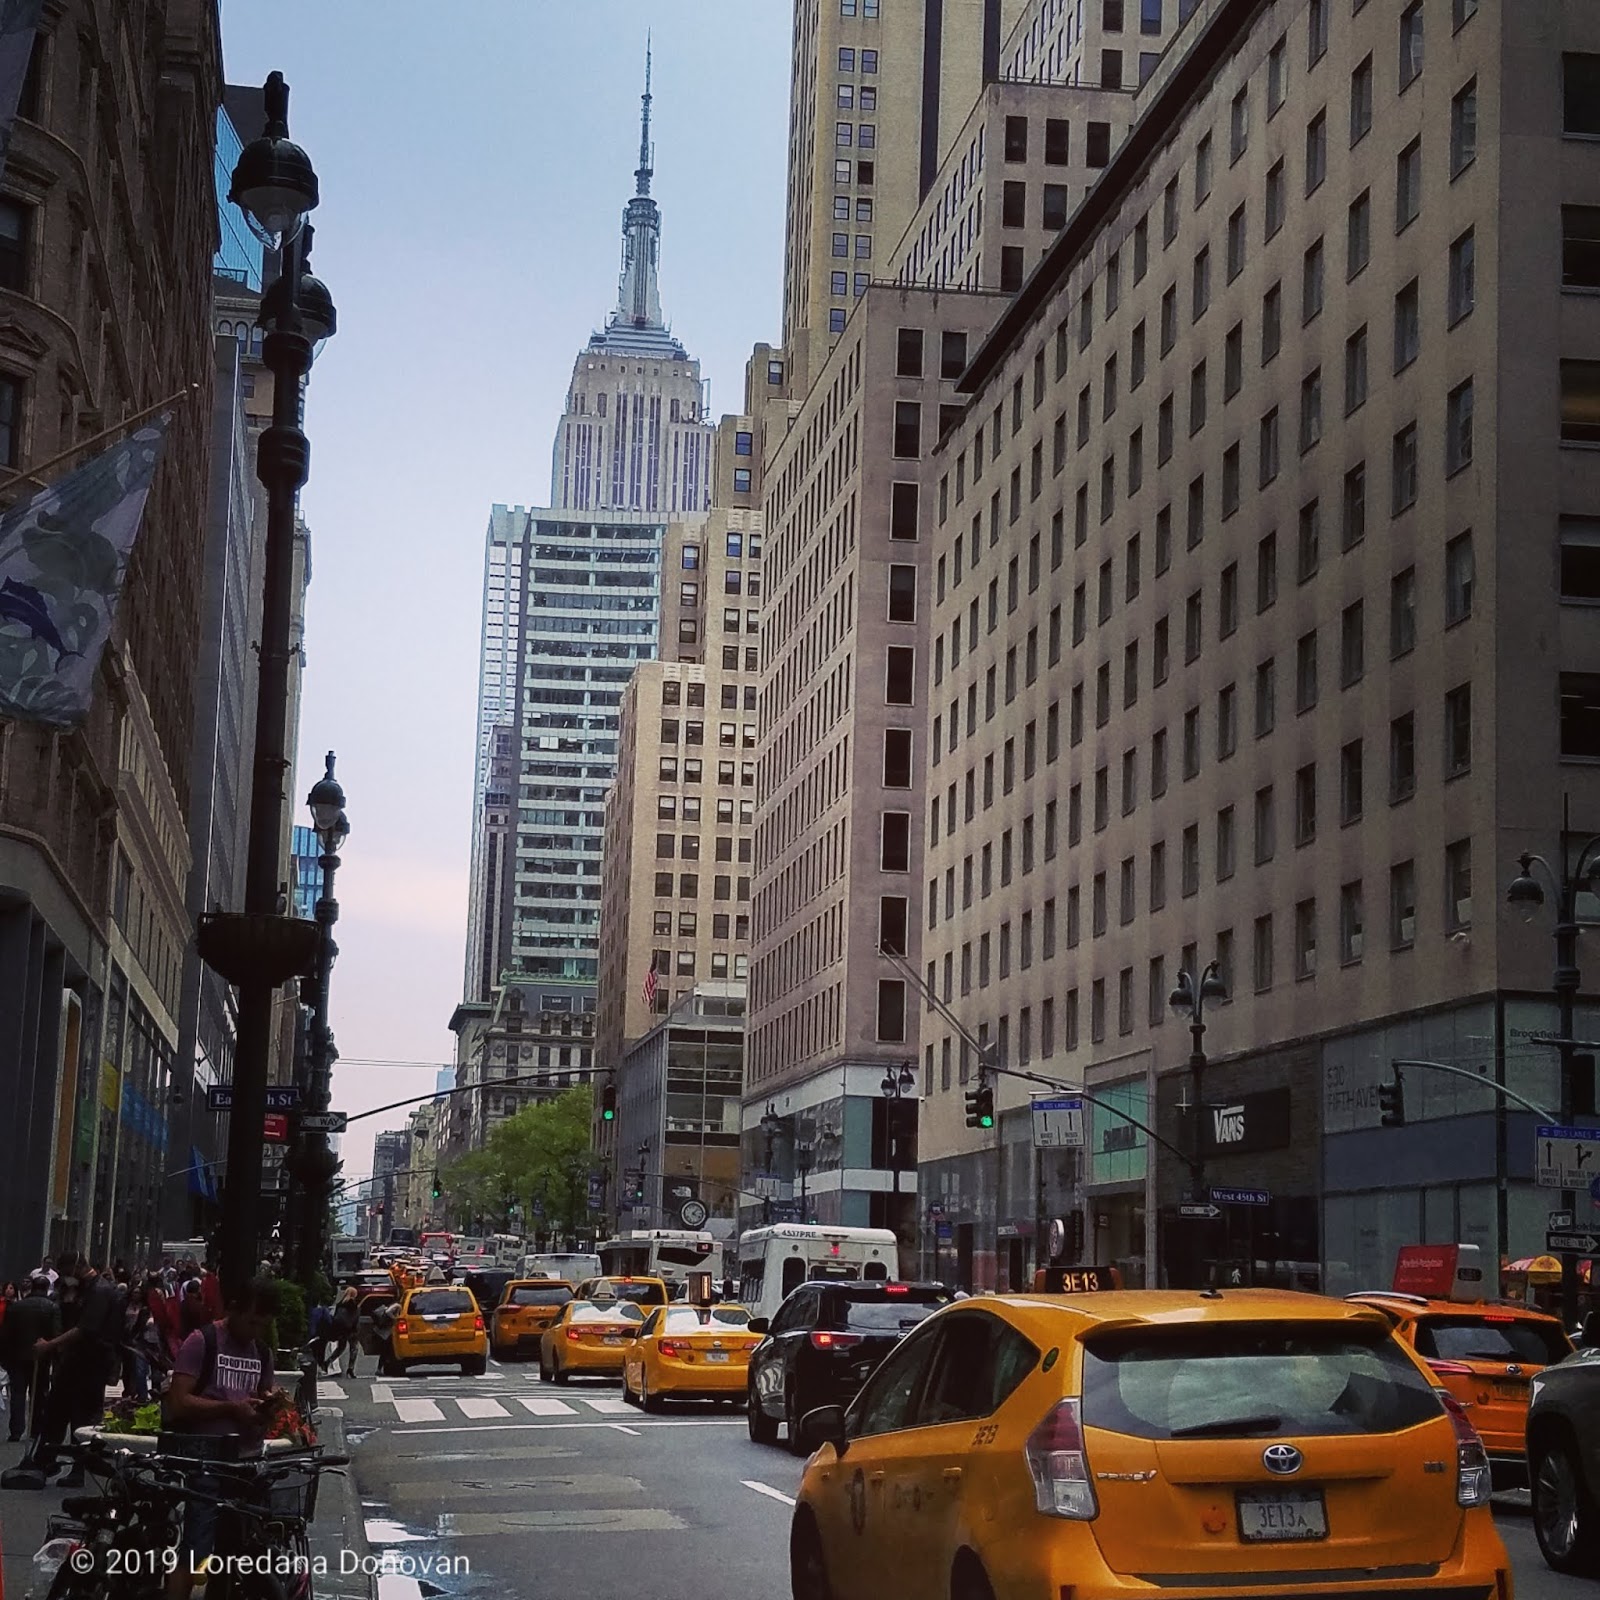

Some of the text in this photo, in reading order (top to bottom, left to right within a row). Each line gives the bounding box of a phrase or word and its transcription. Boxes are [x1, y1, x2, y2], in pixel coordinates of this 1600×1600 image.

[278, 1093, 292, 1105] St
[319, 1117, 339, 1126] WAY
[1213, 1105, 1245, 1143] VANS
[1212, 1191, 1267, 1202] West 45th St
[1554, 1237, 1571, 1247] ONE
[1062, 1272, 1099, 1292] 3E13
